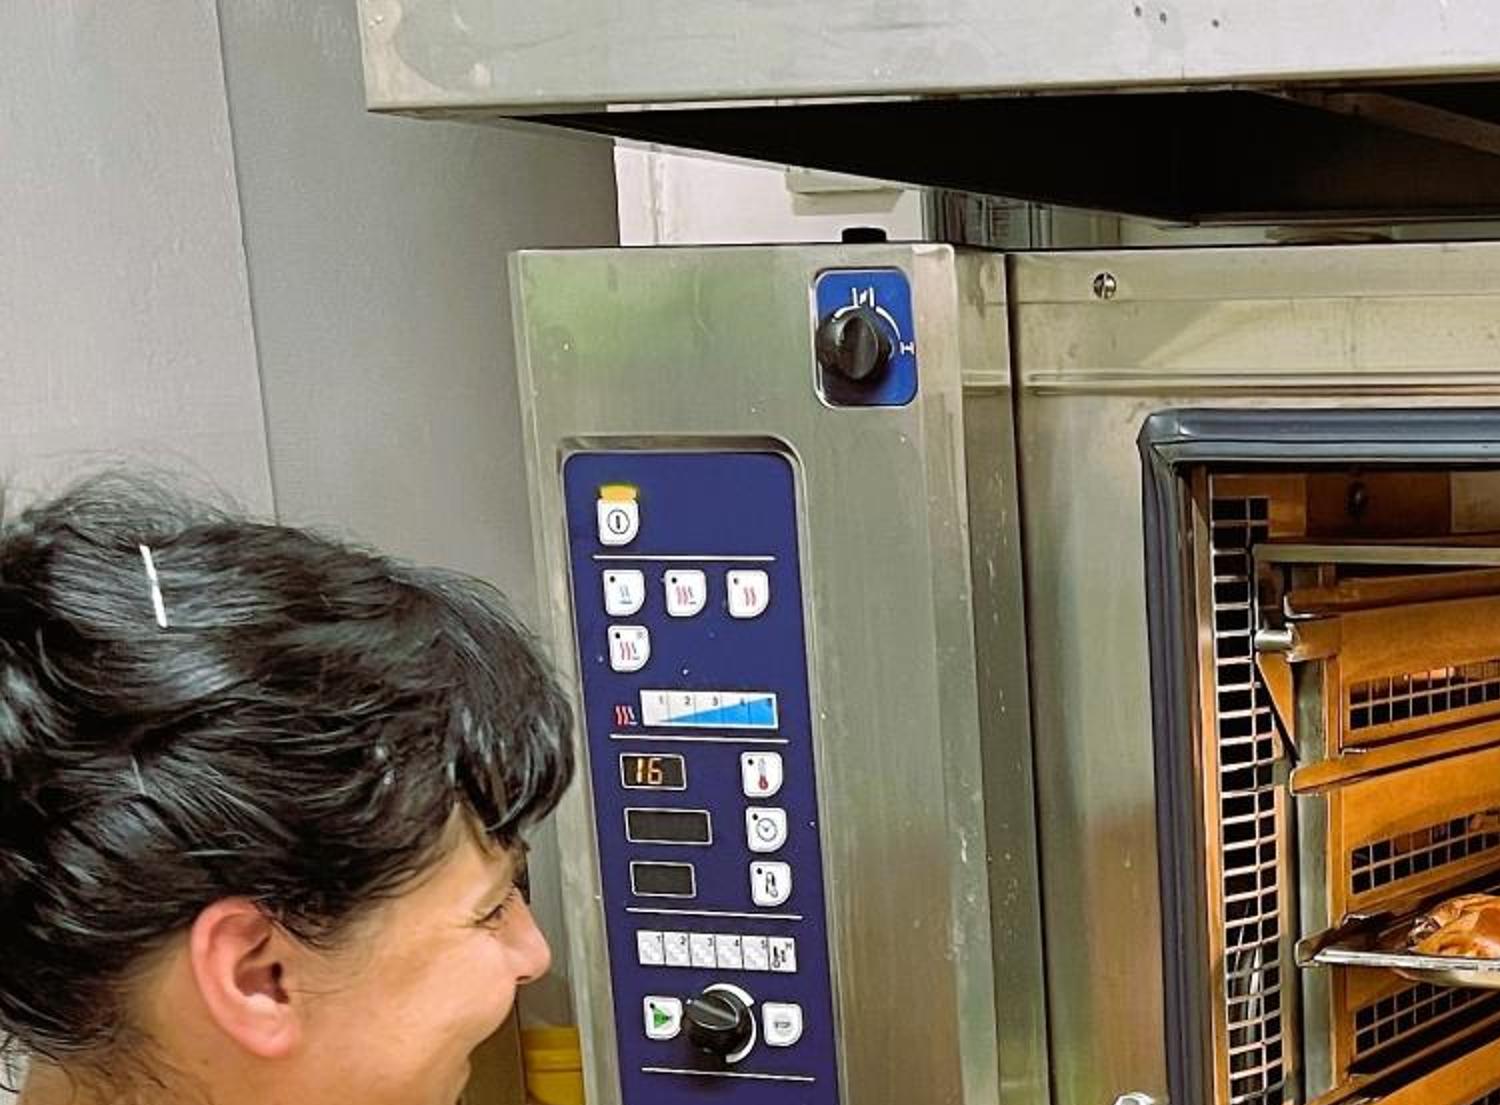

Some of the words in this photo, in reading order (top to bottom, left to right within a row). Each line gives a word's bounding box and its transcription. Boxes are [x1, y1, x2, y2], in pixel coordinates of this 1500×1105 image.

[684, 695, 691, 706] 2
[712, 695, 719, 707] 3
[637, 757, 663, 784] 16
[680, 935, 687, 945] 2
[707, 937, 713, 947] 3
[733, 939, 739, 947] 4
